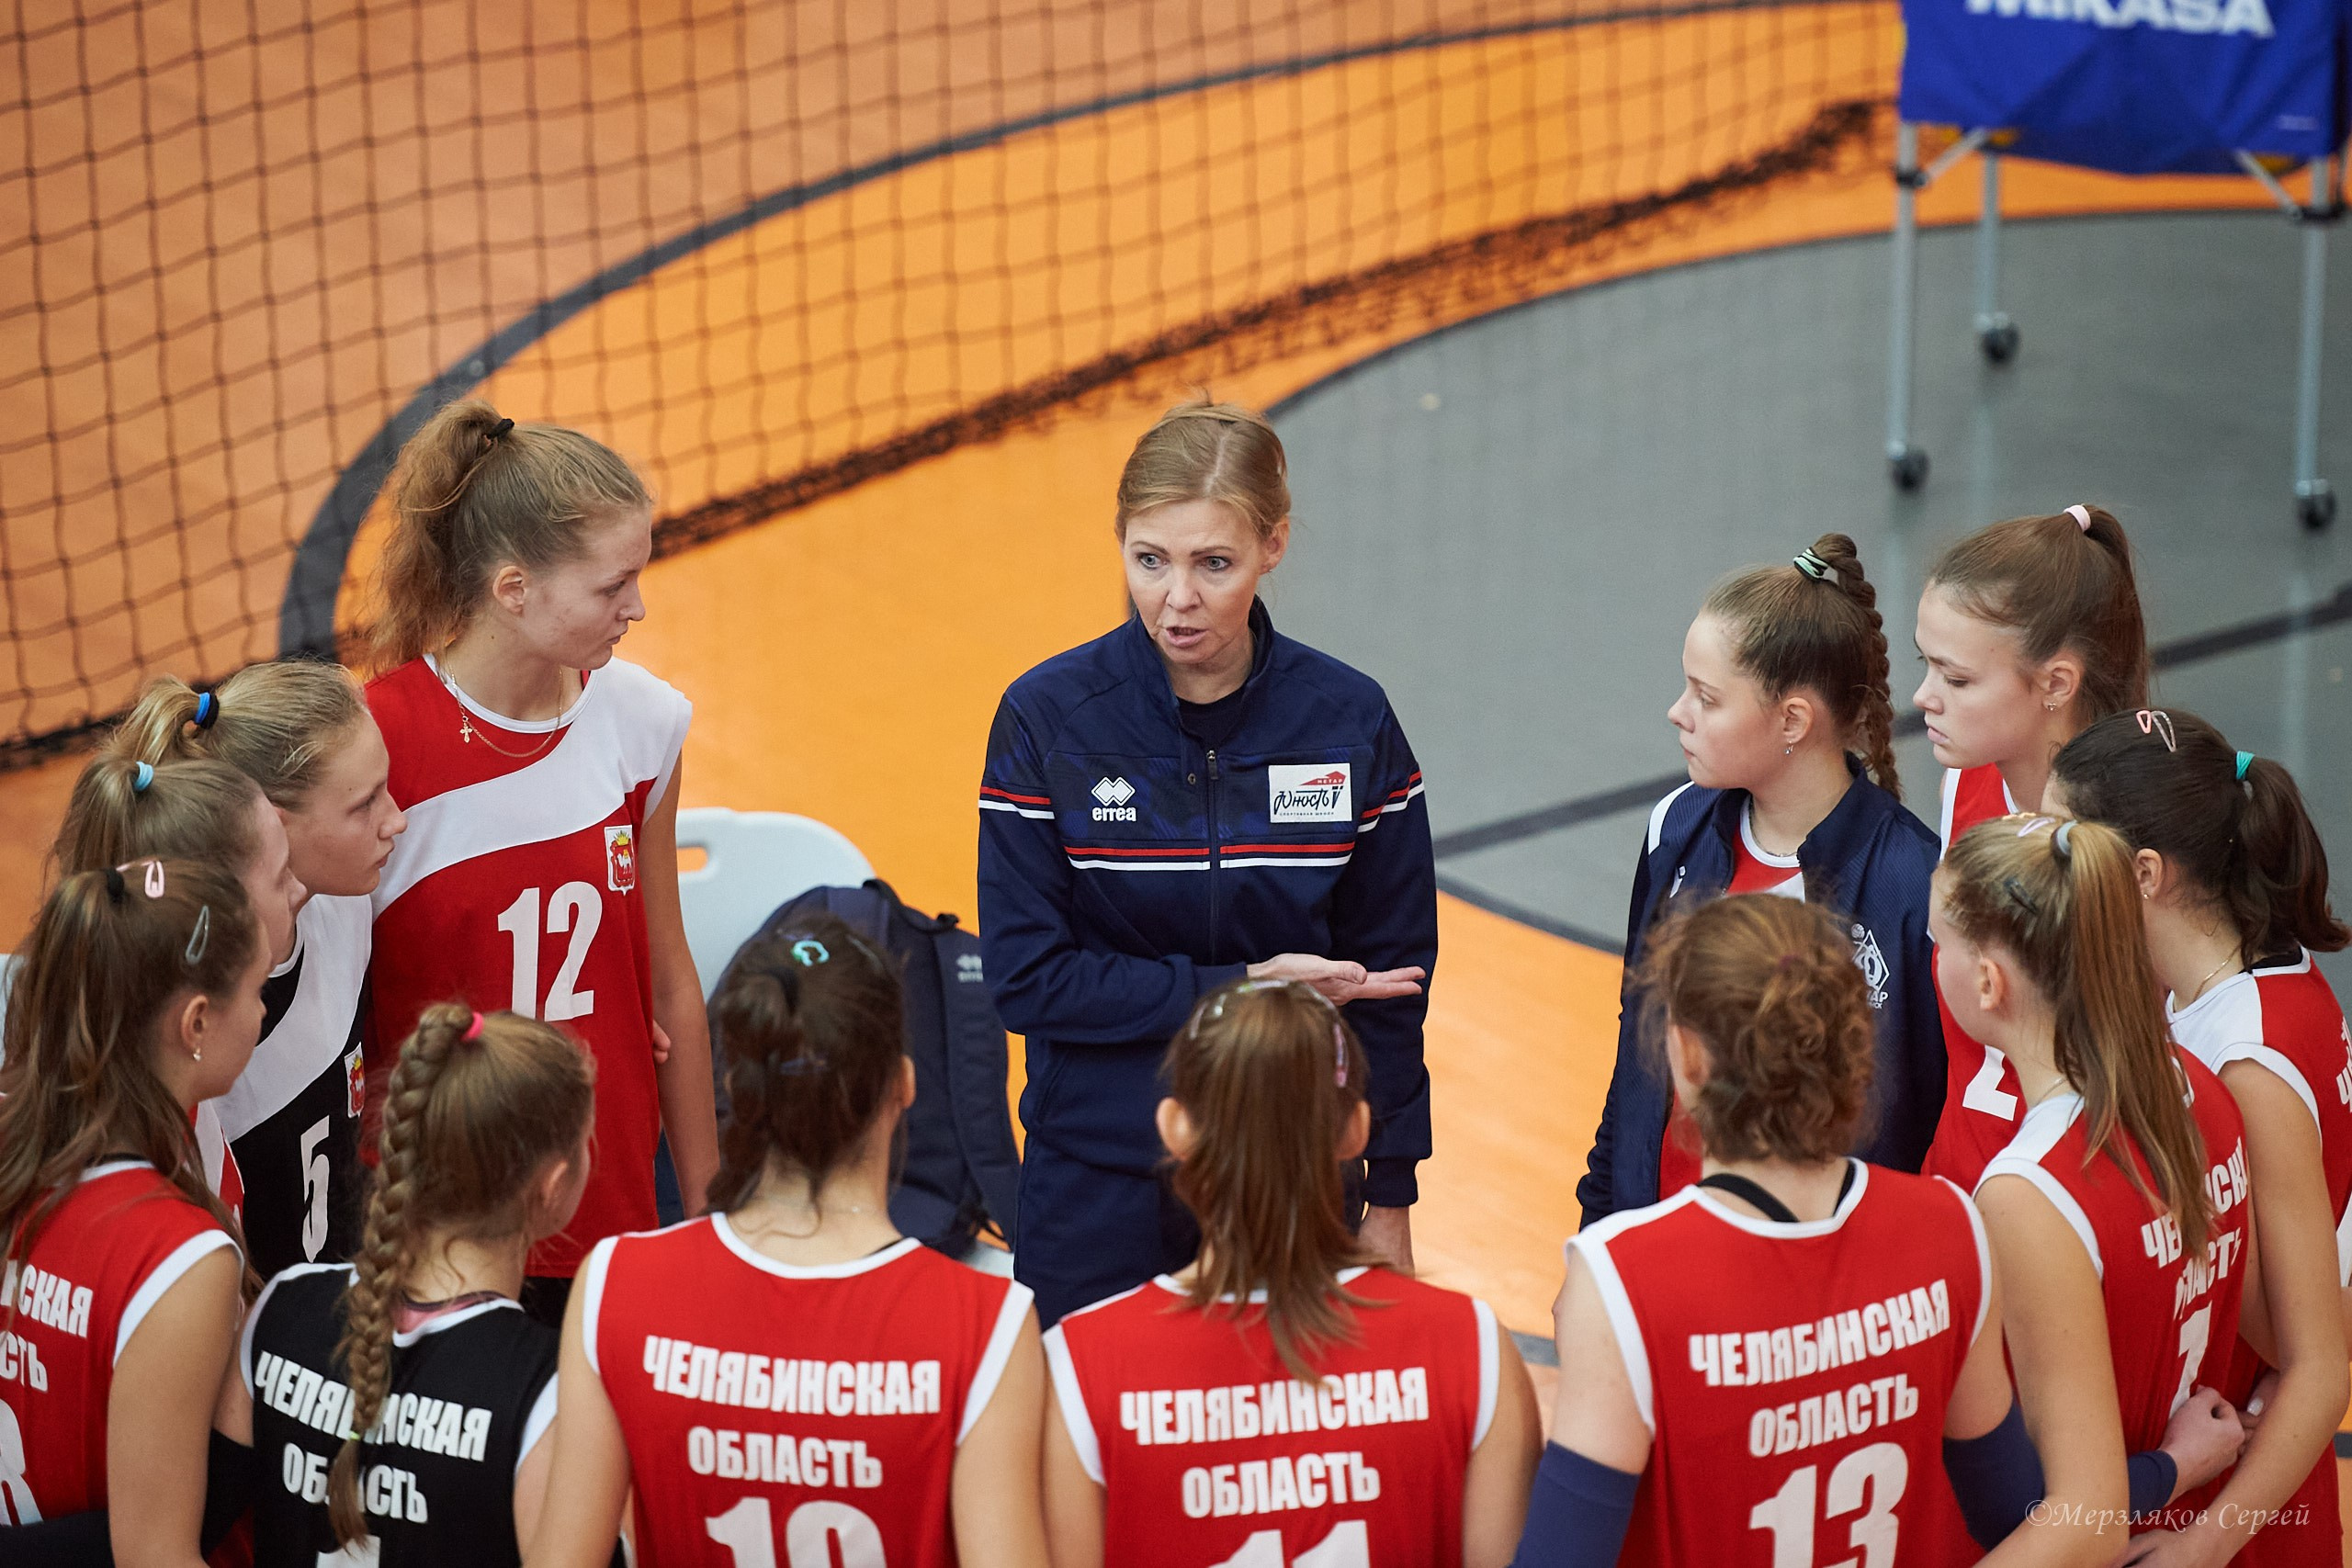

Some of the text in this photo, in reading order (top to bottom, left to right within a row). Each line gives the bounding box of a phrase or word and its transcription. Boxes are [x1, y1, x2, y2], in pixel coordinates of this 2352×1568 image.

[1091, 807, 1136, 822] errea
[498, 882, 603, 1022] 12
[300, 1114, 330, 1263] 5
[1689, 1279, 1951, 1387] ЧЕЛЯБИНСКАЯ
[643, 1335, 941, 1416] ЧЕЛЯБИНСКАЯ
[1120, 1367, 1430, 1446] ЧЕЛЯБИНСКАЯ
[1749, 1373, 1919, 1458] ОБЛАСТЬ
[282, 1442, 429, 1524] ОБСТЬ
[688, 1426, 883, 1488] ОБЛАСТЬ
[1182, 1451, 1381, 1518] ОБЛАСТЬ
[1749, 1441, 1909, 1568] 13
